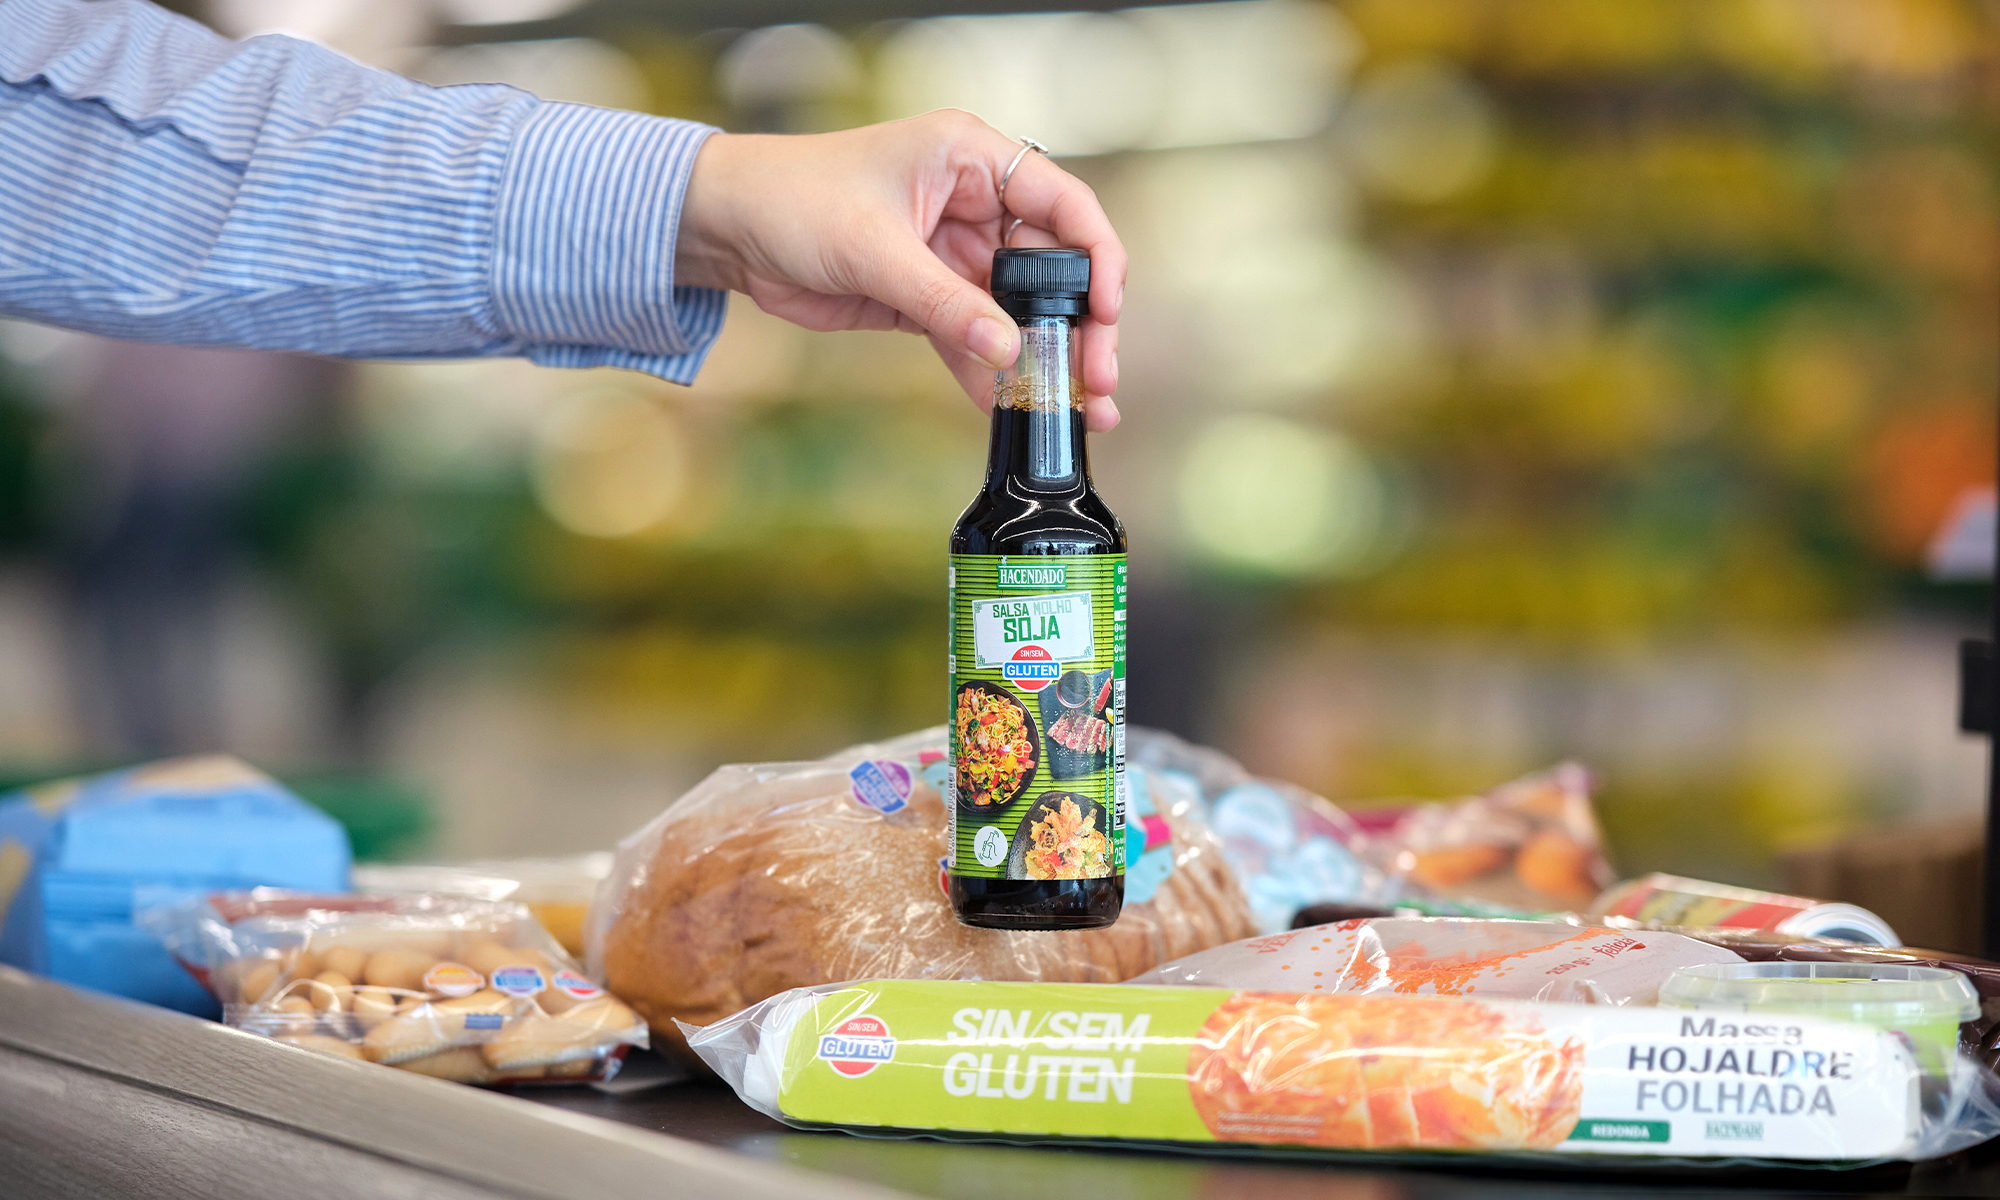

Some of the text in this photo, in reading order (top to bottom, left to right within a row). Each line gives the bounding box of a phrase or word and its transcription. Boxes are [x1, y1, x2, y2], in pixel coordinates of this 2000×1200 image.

[999, 568, 1064, 584] HACENDADO
[993, 599, 1072, 618] SALSA MOLHO
[1003, 615, 1061, 643] SOJA
[1020, 649, 1044, 658] SIN/SEM
[1006, 664, 1058, 677] GLUTEN
[847, 1022, 879, 1032] SIN/SEM
[947, 1007, 1152, 1052] SIN/SEM
[1680, 1016, 1803, 1046] Massa
[824, 1039, 892, 1057] GLUTEN
[1628, 1045, 1853, 1080] HOJALDRE
[943, 1052, 1136, 1104] GLUTEN
[1635, 1080, 1837, 1117] FOLHADA
[1591, 1123, 1650, 1139] REDONDA
